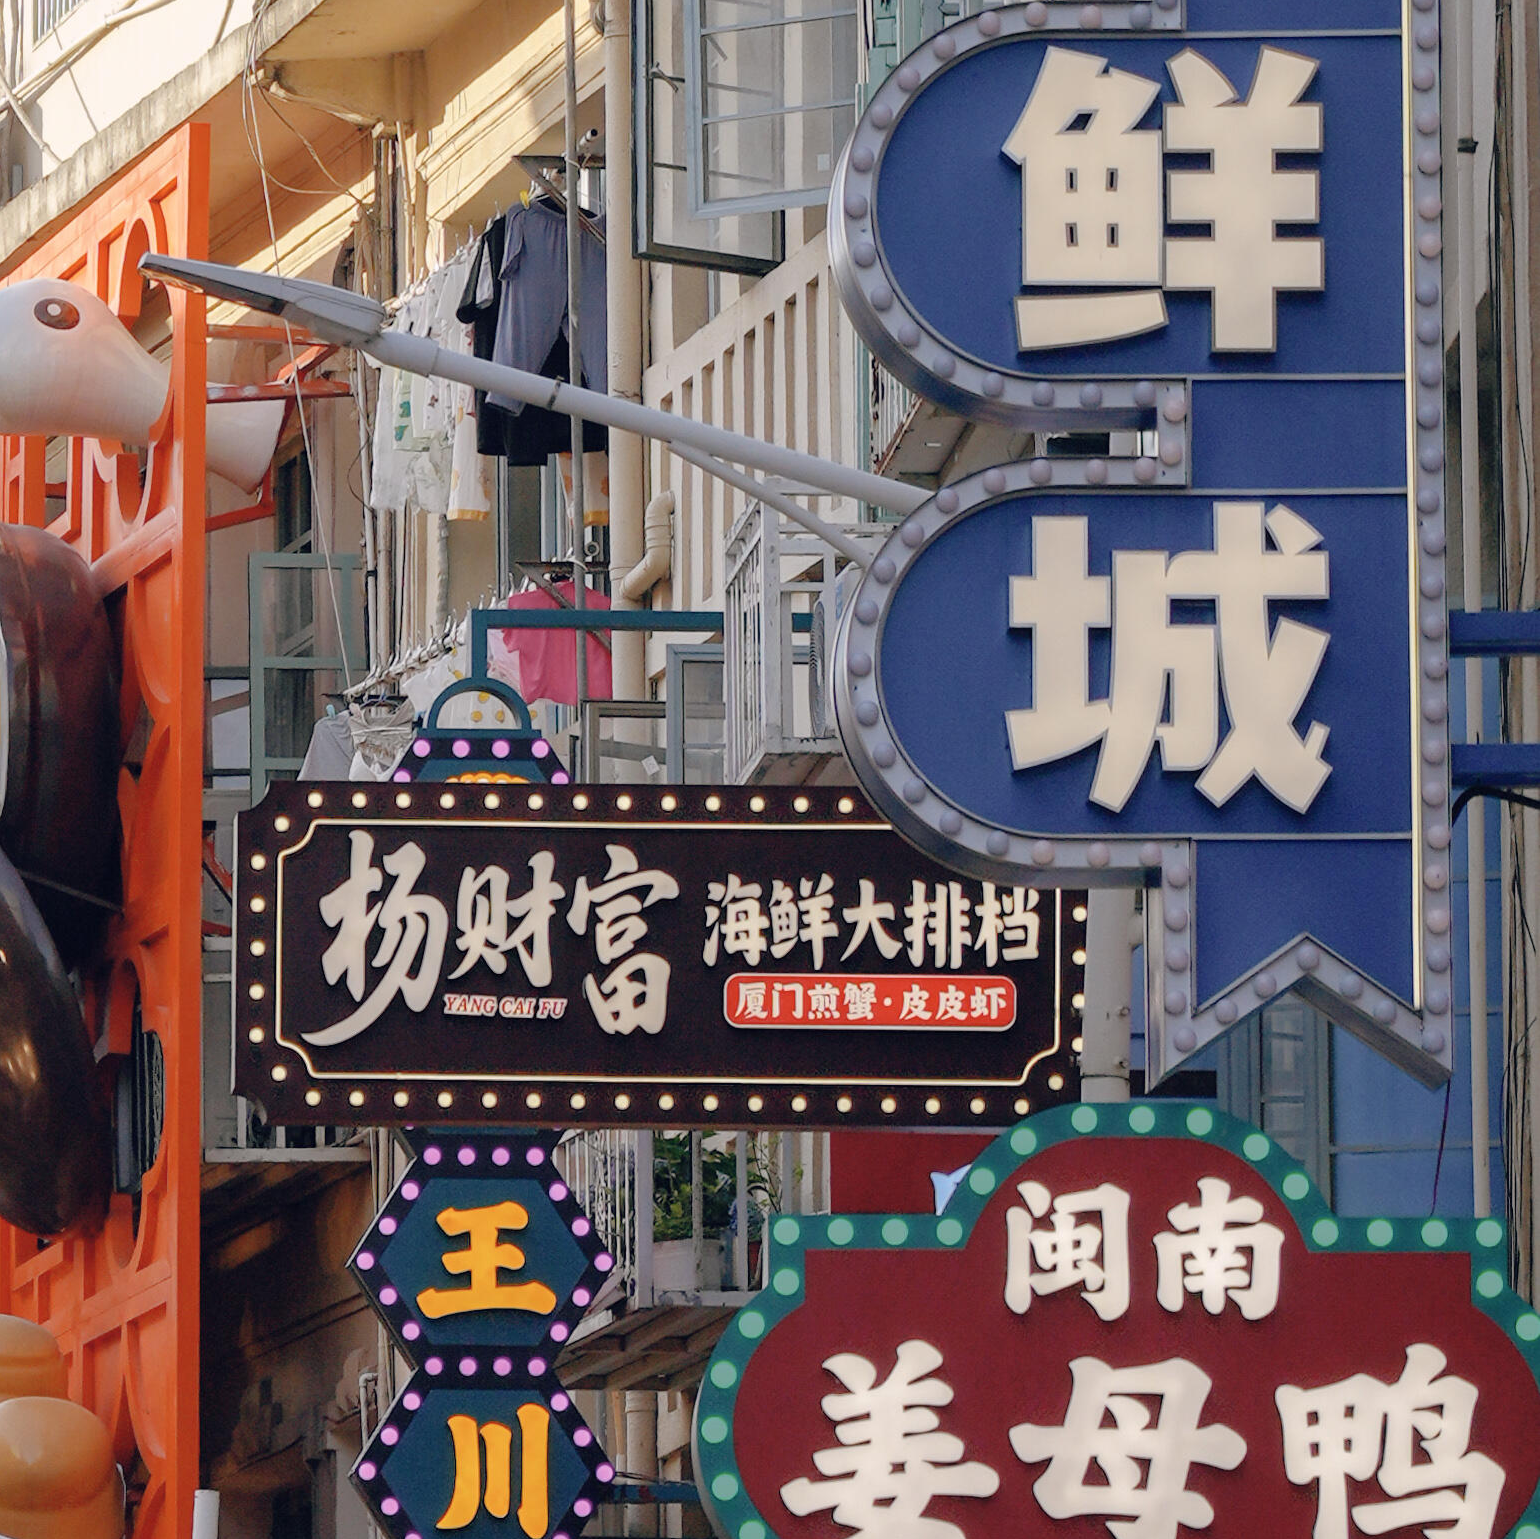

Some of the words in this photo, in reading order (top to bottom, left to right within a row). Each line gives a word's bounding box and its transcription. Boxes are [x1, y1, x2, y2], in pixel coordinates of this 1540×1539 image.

[300, 829, 680, 1046] 杨财富
[701, 872, 1040, 972] 海鲜大排档
[443, 994, 496, 1017] YANG
[498, 996, 537, 1018] CAI
[539, 997, 568, 1020] FU
[733, 981, 1007, 1022] 厦门煎蟹·皮皮虾
[1003, 1176, 1286, 1324] 闽南
